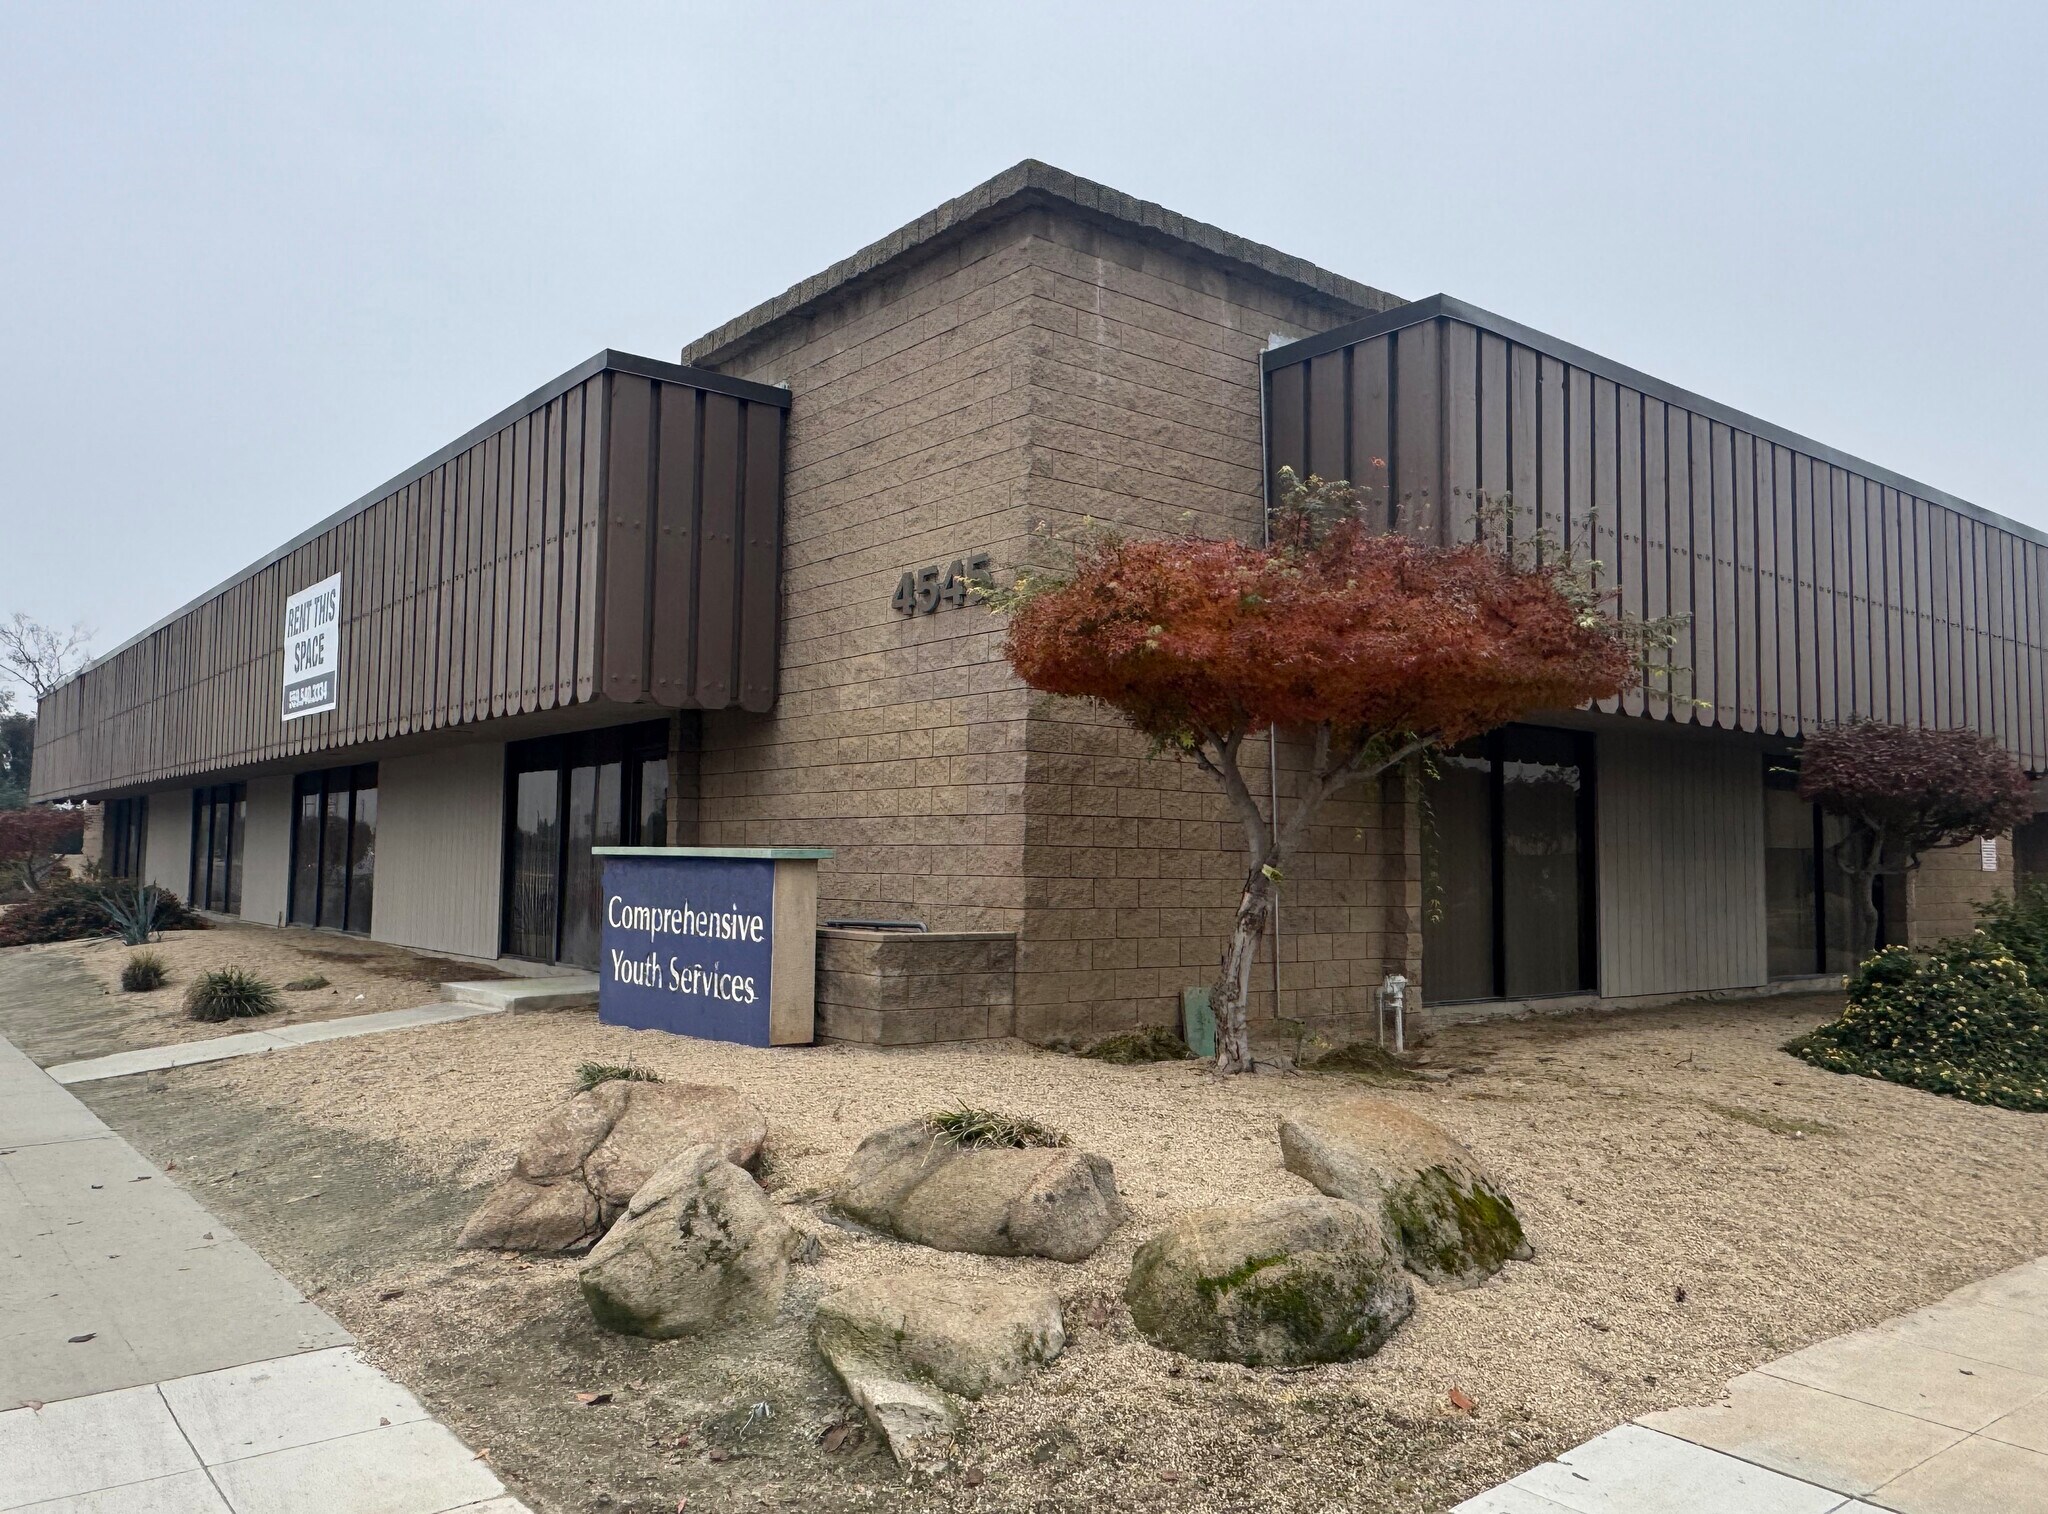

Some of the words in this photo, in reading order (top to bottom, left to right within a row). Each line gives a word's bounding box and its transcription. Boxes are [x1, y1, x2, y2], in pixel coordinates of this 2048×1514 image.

[891, 552, 994, 616] 4545
[287, 600, 312, 638] RENT
[314, 589, 336, 628] THIS
[294, 633, 325, 674] SPACE
[608, 896, 765, 943] Comprehensive
[611, 948, 663, 989] Youth
[669, 956, 759, 1004] Services
